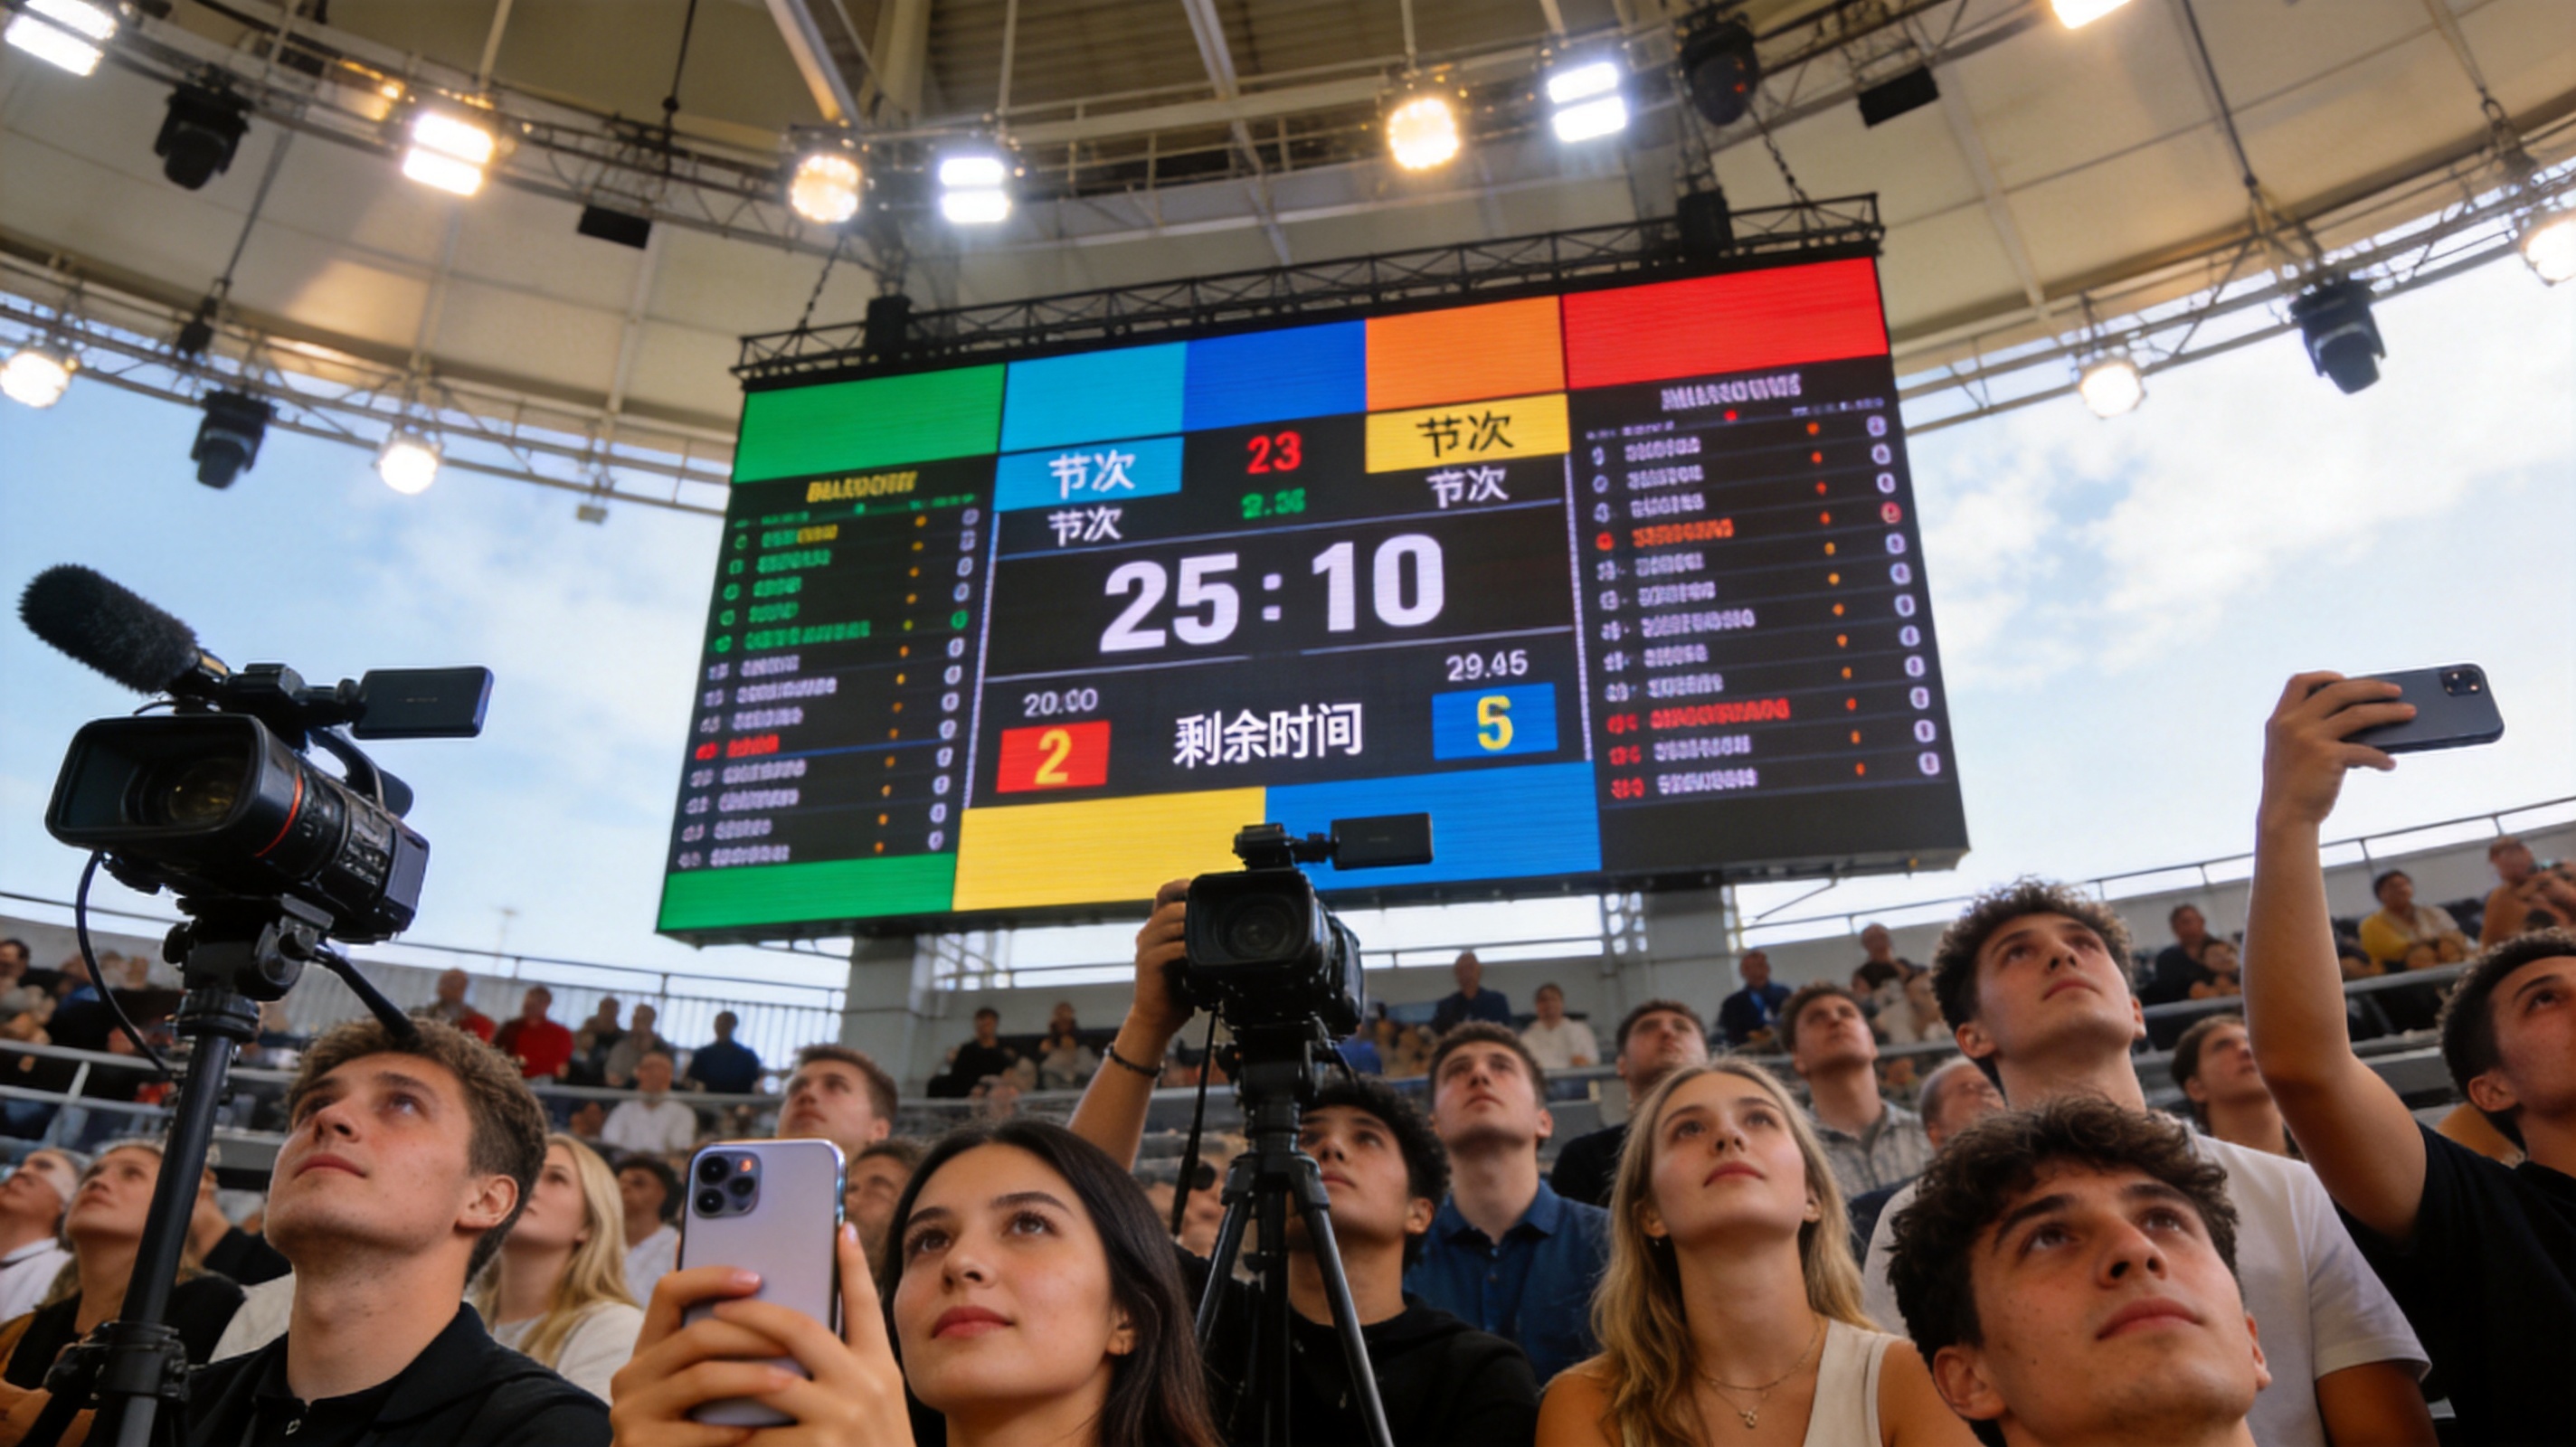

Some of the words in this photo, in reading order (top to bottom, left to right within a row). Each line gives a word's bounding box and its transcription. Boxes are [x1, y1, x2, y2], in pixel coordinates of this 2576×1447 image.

[1246, 430, 1302, 475] 23
[1416, 411, 1514, 458] 节次
[1049, 449, 1136, 500] 节次
[1426, 464, 1510, 509] 节次
[1047, 505, 1123, 547] 节次
[1172, 702, 1364, 770] 剩余时间
[1477, 695, 1514, 752] 5
[1034, 729, 1072, 785] 2
